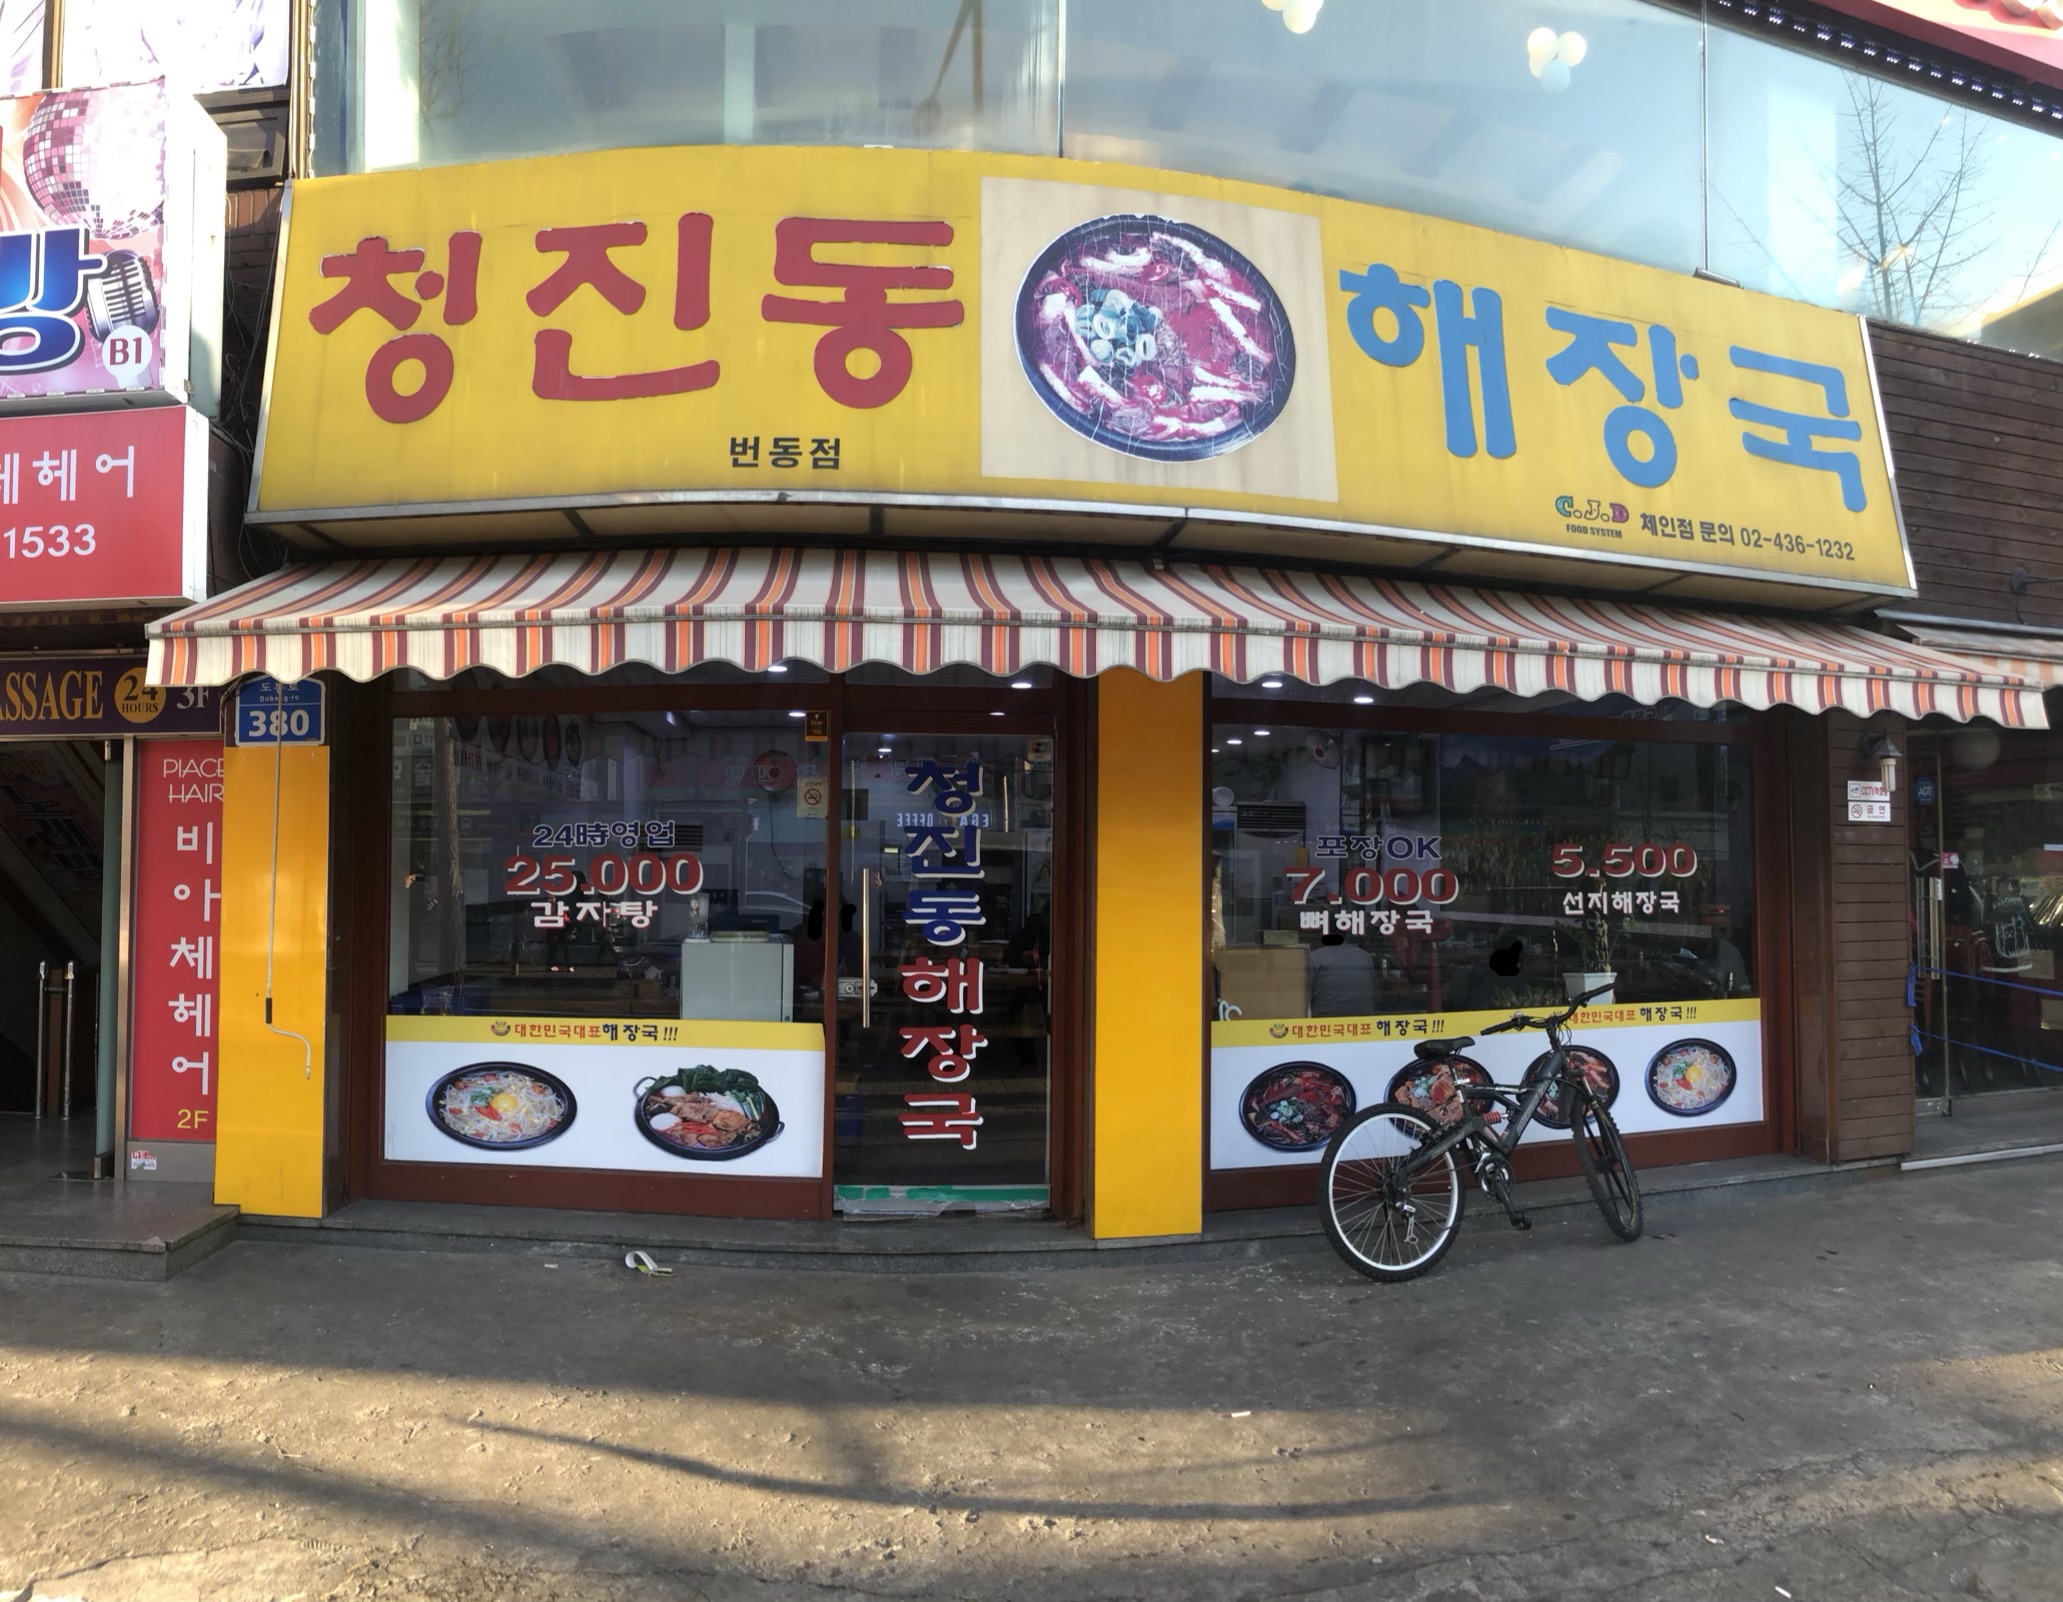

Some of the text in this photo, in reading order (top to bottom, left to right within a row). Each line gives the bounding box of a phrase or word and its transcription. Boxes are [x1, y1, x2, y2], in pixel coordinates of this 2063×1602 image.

[308, 212, 964, 424] 청진동
[108, 335, 145, 366] B1
[1339, 263, 1867, 512] 해장국
[729, 436, 842, 471] 번동점
[1555, 495, 1630, 524] C.J.D
[2, 523, 96, 559] 1533
[1566, 523, 1622, 539] FOOD SYSTEM
[1640, 512, 1855, 561] 체인점 문의 02-436-1232
[0, 670, 103, 721] SSAGE
[123, 675, 159, 701] 24
[121, 702, 159, 714] HOURS
[248, 709, 310, 737] 380
[163, 758, 224, 778] PIACE
[168, 783, 224, 803] HAIR
[1918, 786, 1933, 796] ADT
[532, 820, 676, 848] 24時영업
[1315, 834, 1442, 861] 포장OK
[504, 852, 704, 896] 25.000
[1551, 843, 1698, 879] 5.500
[1283, 866, 1460, 906] 7.000
[530, 901, 659, 929] 감자탕
[1562, 890, 1681, 916] 선지해장국
[1299, 910, 1434, 937] 뼈해장국
[167, 822, 221, 1096] 비아체헤어
[900, 761, 988, 1150] 청진동해장국
[514, 1023, 601, 1038] 대한민국대표
[1292, 1022, 1373, 1039] 대한민국대표
[1570, 1008, 1637, 1025] 대한민국대표
[177, 1109, 209, 1130] 2F
